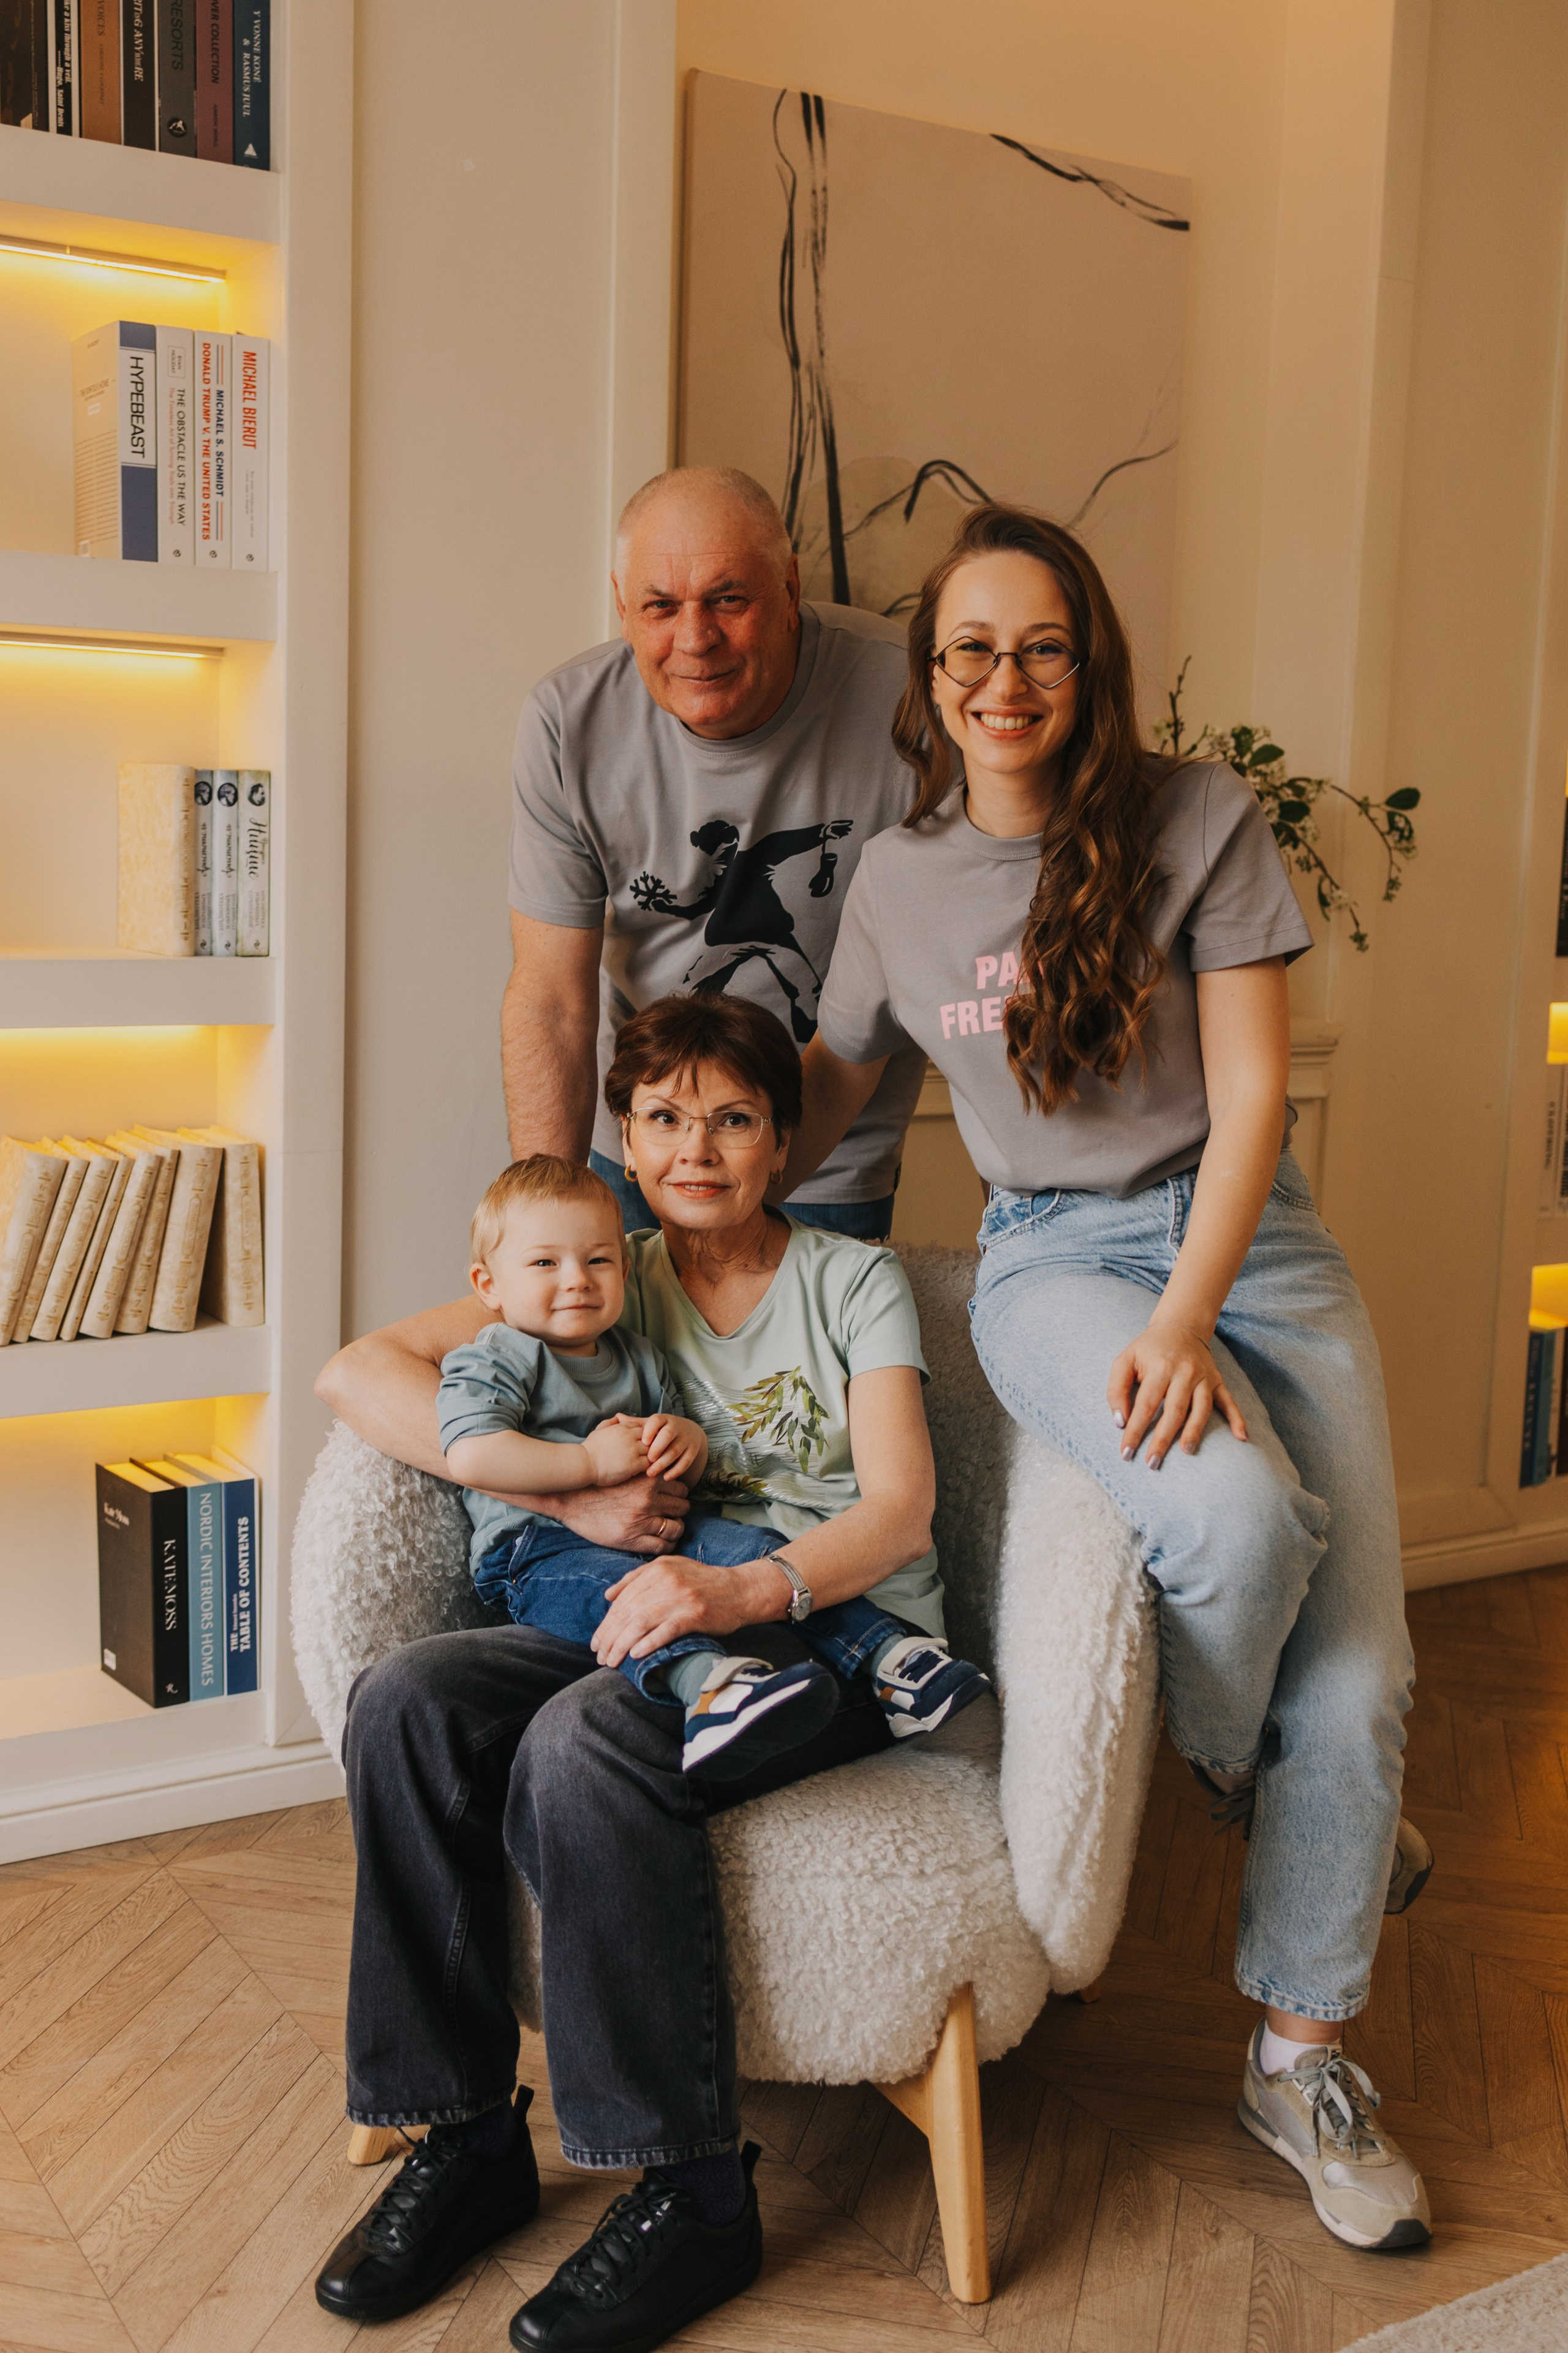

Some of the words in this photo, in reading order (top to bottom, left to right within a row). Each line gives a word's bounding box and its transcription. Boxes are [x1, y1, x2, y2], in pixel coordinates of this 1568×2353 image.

[211, 0, 219, 20] VER
[171, 0, 184, 71] RESORTS
[211, 23, 219, 84] COLLECTION
[241, 93, 250, 117] JUUL
[202, 343, 211, 385] DONALD
[243, 351, 257, 403] MICHAEL
[130, 356, 145, 458] HYPEBEAST
[177, 388, 186, 407] THE
[202, 388, 211, 423] TRUMP
[216, 390, 224, 435] MICHAEL
[177, 410, 186, 461] OBSTACLE
[202, 439, 211, 458] THE
[216, 439, 224, 447] S.
[243, 407, 257, 450] BIERUT
[177, 464, 186, 478] US
[177, 482, 186, 500] THE
[202, 462, 211, 499] UNITED
[216, 450, 224, 497] SCHMIDT
[176, 503, 186, 526] WAY
[202, 502, 211, 540] STATES
[940, 995, 1015, 1040] FRE
[200, 1493, 213, 1551] NORDIC
[238, 1516, 251, 1587] CONTENTS
[200, 1554, 213, 1629] INTERIORS
[239, 1589, 251, 1609] OF
[239, 1610, 251, 1653] TABLE
[201, 1633, 214, 1686] HOMES
